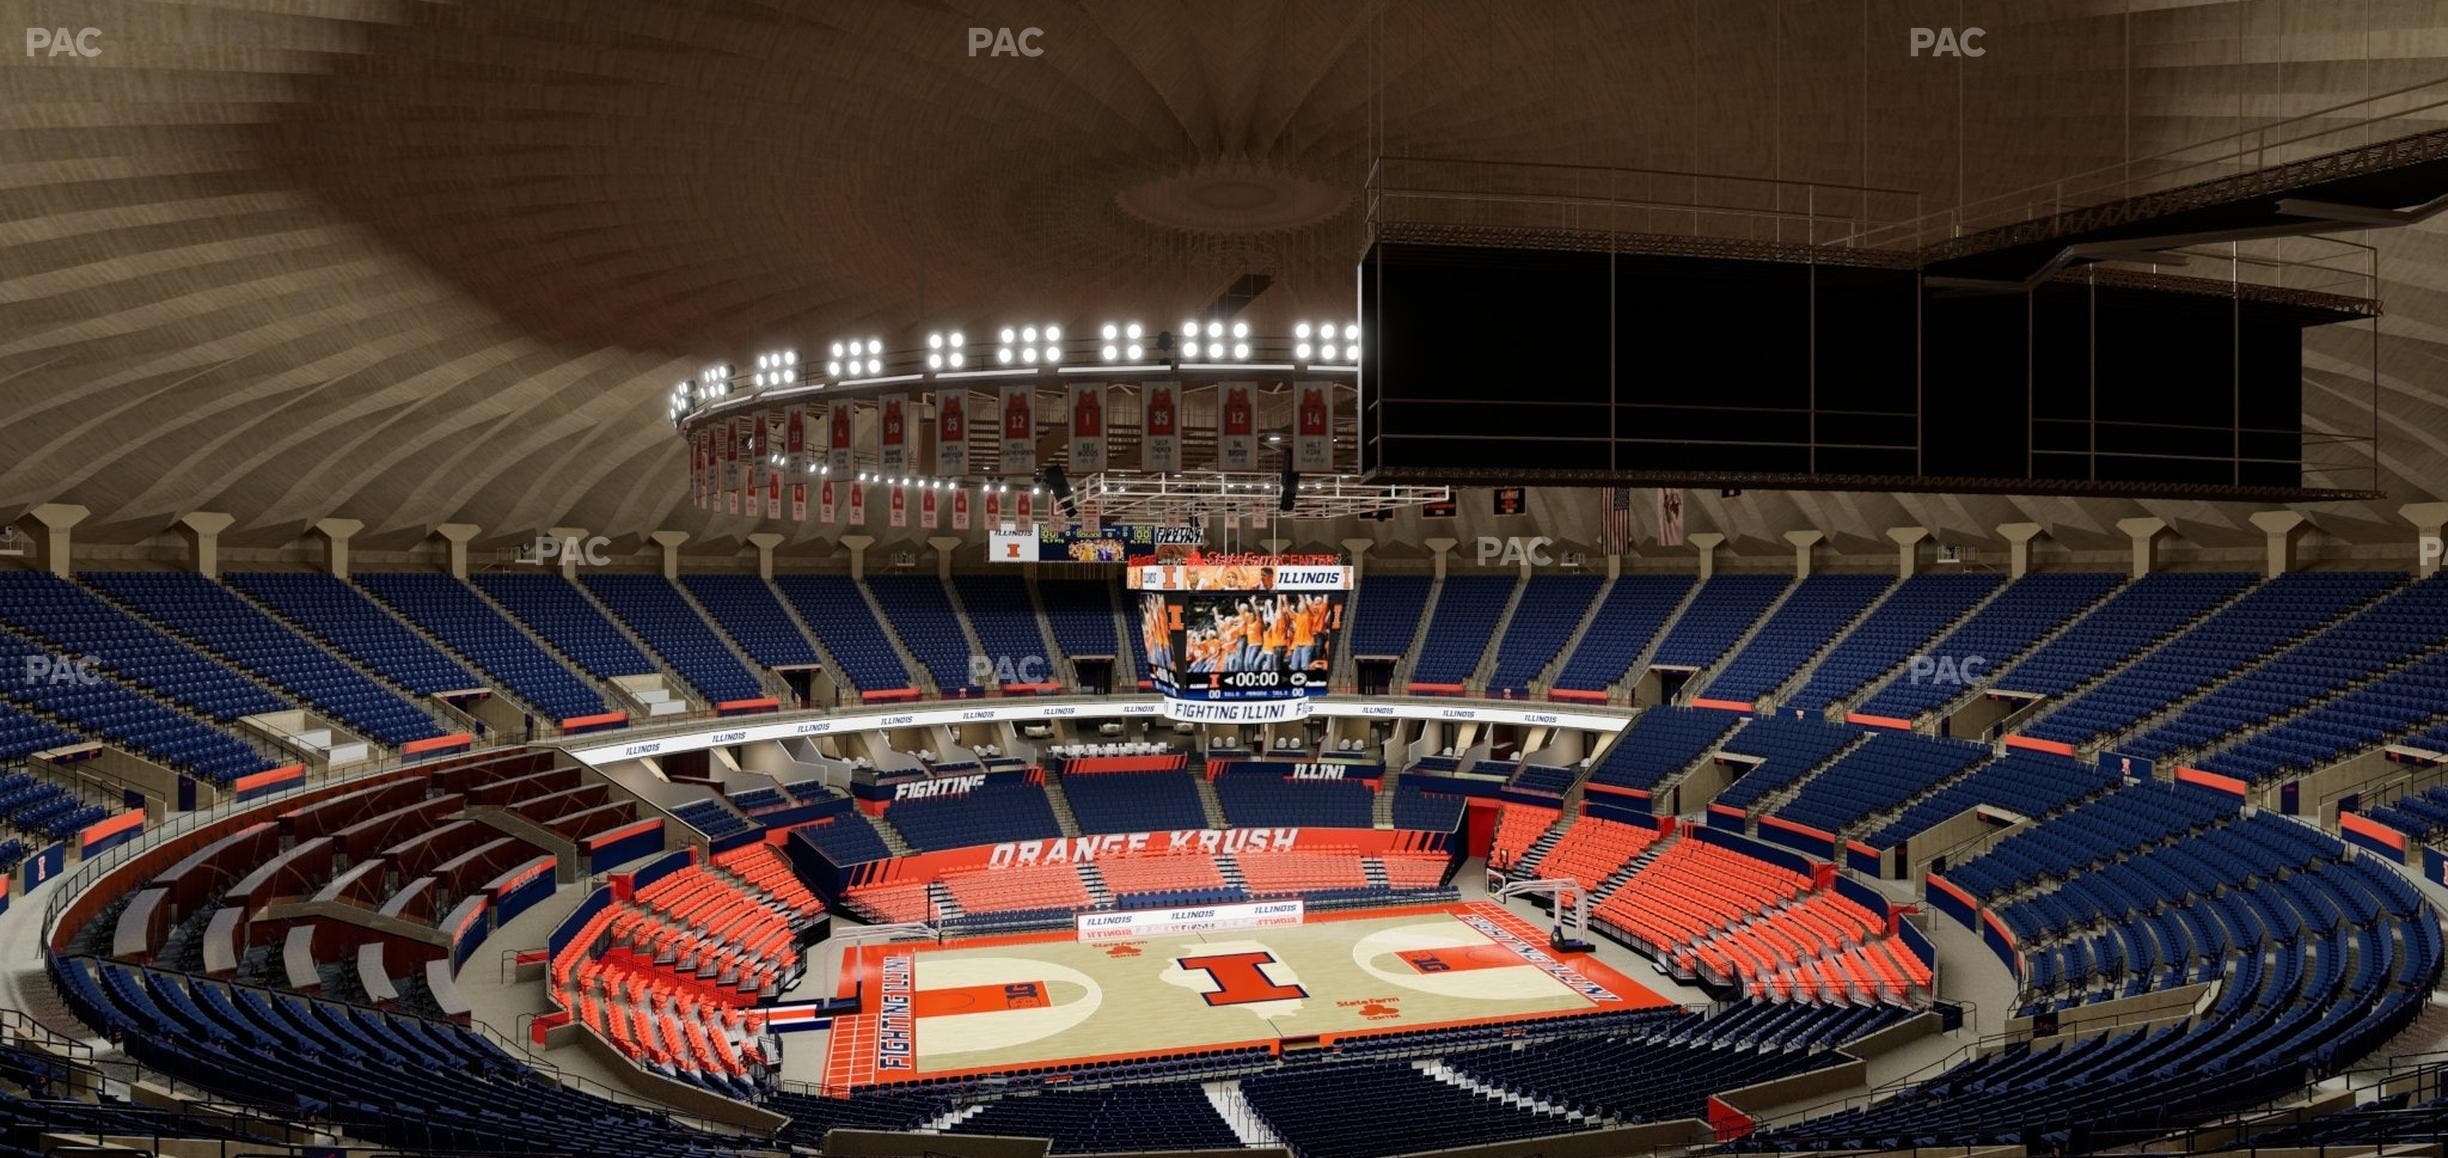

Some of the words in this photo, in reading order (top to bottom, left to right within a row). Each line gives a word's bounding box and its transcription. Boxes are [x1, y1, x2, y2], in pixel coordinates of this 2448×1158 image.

[1012, 416, 1024, 429] 12
[1154, 411, 1169, 425] 35
[1231, 411, 1245, 424] 12
[1307, 412, 1321, 425] 14
[993, 529, 1033, 537] ILLINOIS
[1280, 554, 1335, 566] CENTER
[1278, 572, 1340, 584] ILLINOIS
[1235, 672, 1279, 687] 00:00
[1208, 690, 1221, 699] 00
[1292, 688, 1305, 697] 00
[963, 711, 995, 720] ILLINOIS
[1043, 707, 1075, 716] ILLINOIS
[1123, 705, 1155, 714] ILLINOIS
[1175, 703, 1239, 719] FIGHTING
[1242, 704, 1286, 719] ILLINI
[1362, 706, 1394, 715] ILLINOIS
[1443, 710, 1475, 719] ILLINOIS
[880, 716, 913, 726] ILLINOIS
[1524, 714, 1557, 724] ILLINOIS
[797, 722, 831, 733] ILLINOIS
[712, 731, 747, 743] ILLINOIS
[625, 743, 661, 756] ILLINOIS
[1293, 763, 1346, 780] ILLINI
[895, 774, 986, 801] FIGHTING
[1168, 828, 1298, 854] KRUSH
[1171, 909, 1215, 920] ILLINOIS
[1254, 904, 1297, 914] ILLINOIS
[1087, 915, 1133, 926] ILLINOIS
[883, 956, 910, 992] ILLINI
[879, 993, 911, 1070] FIGHTING
